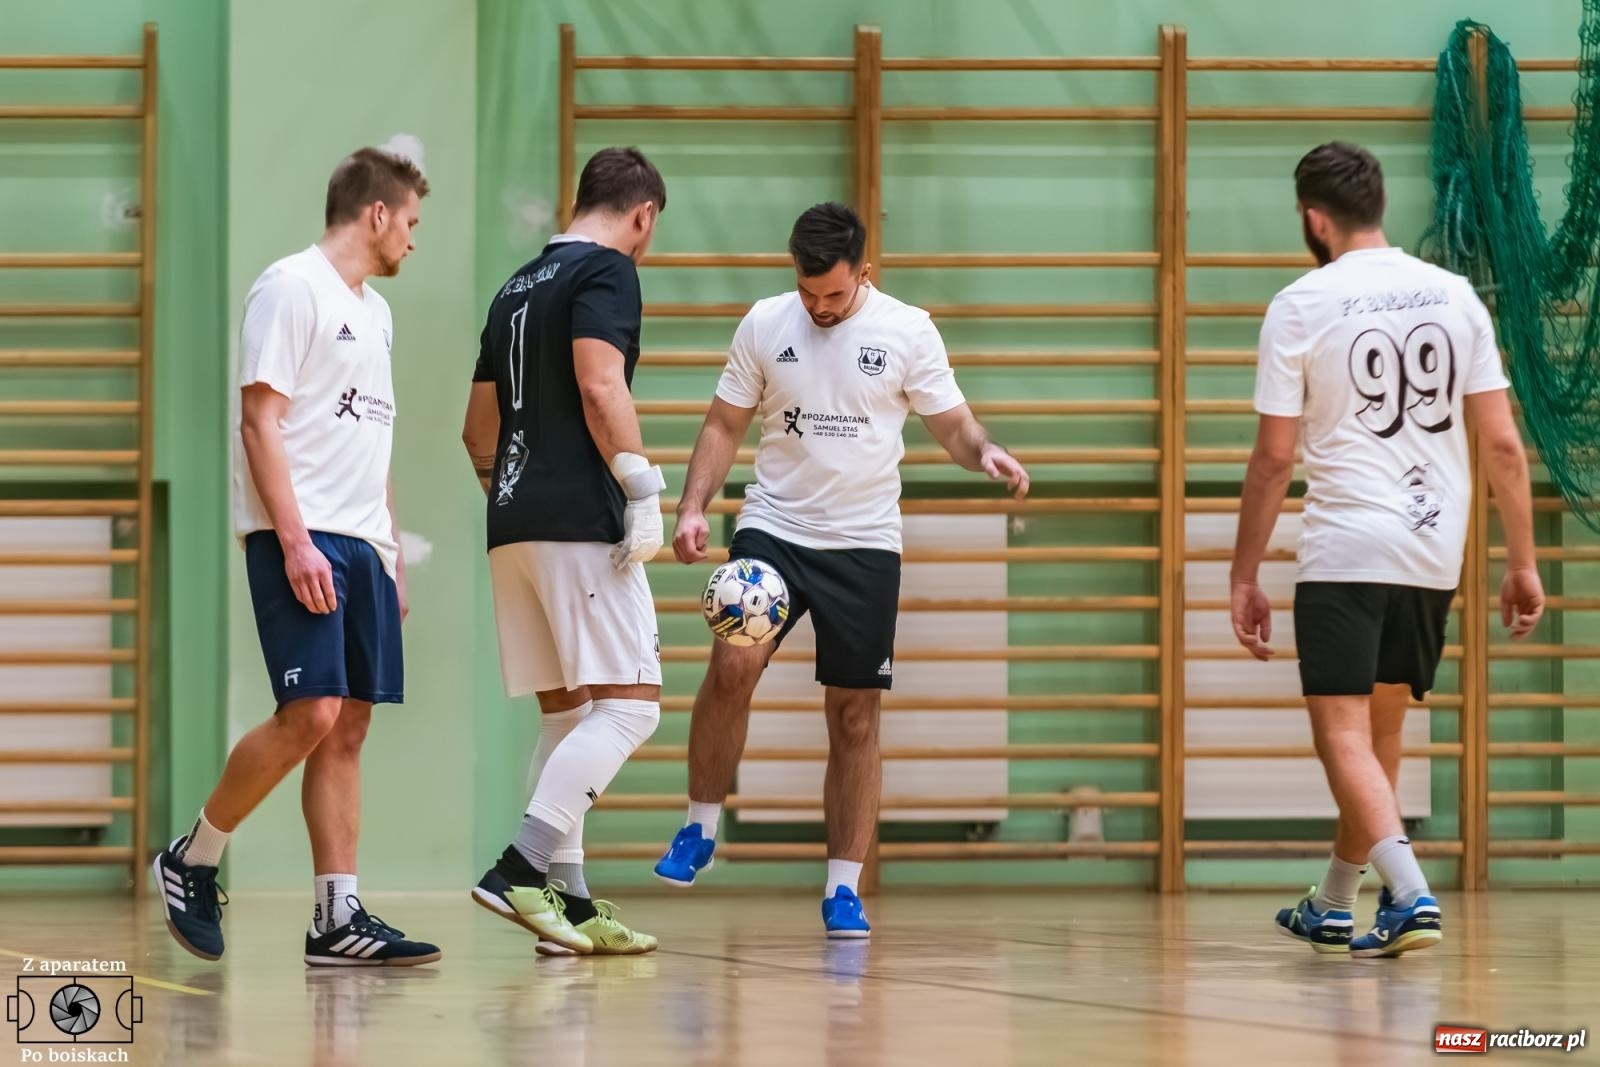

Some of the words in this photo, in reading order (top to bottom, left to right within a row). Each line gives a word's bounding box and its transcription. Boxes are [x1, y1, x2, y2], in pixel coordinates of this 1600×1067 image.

[1348, 322, 1456, 438] 99
[801, 413, 871, 424] #POZAMIATANE
[704, 568, 726, 613] SELECT
